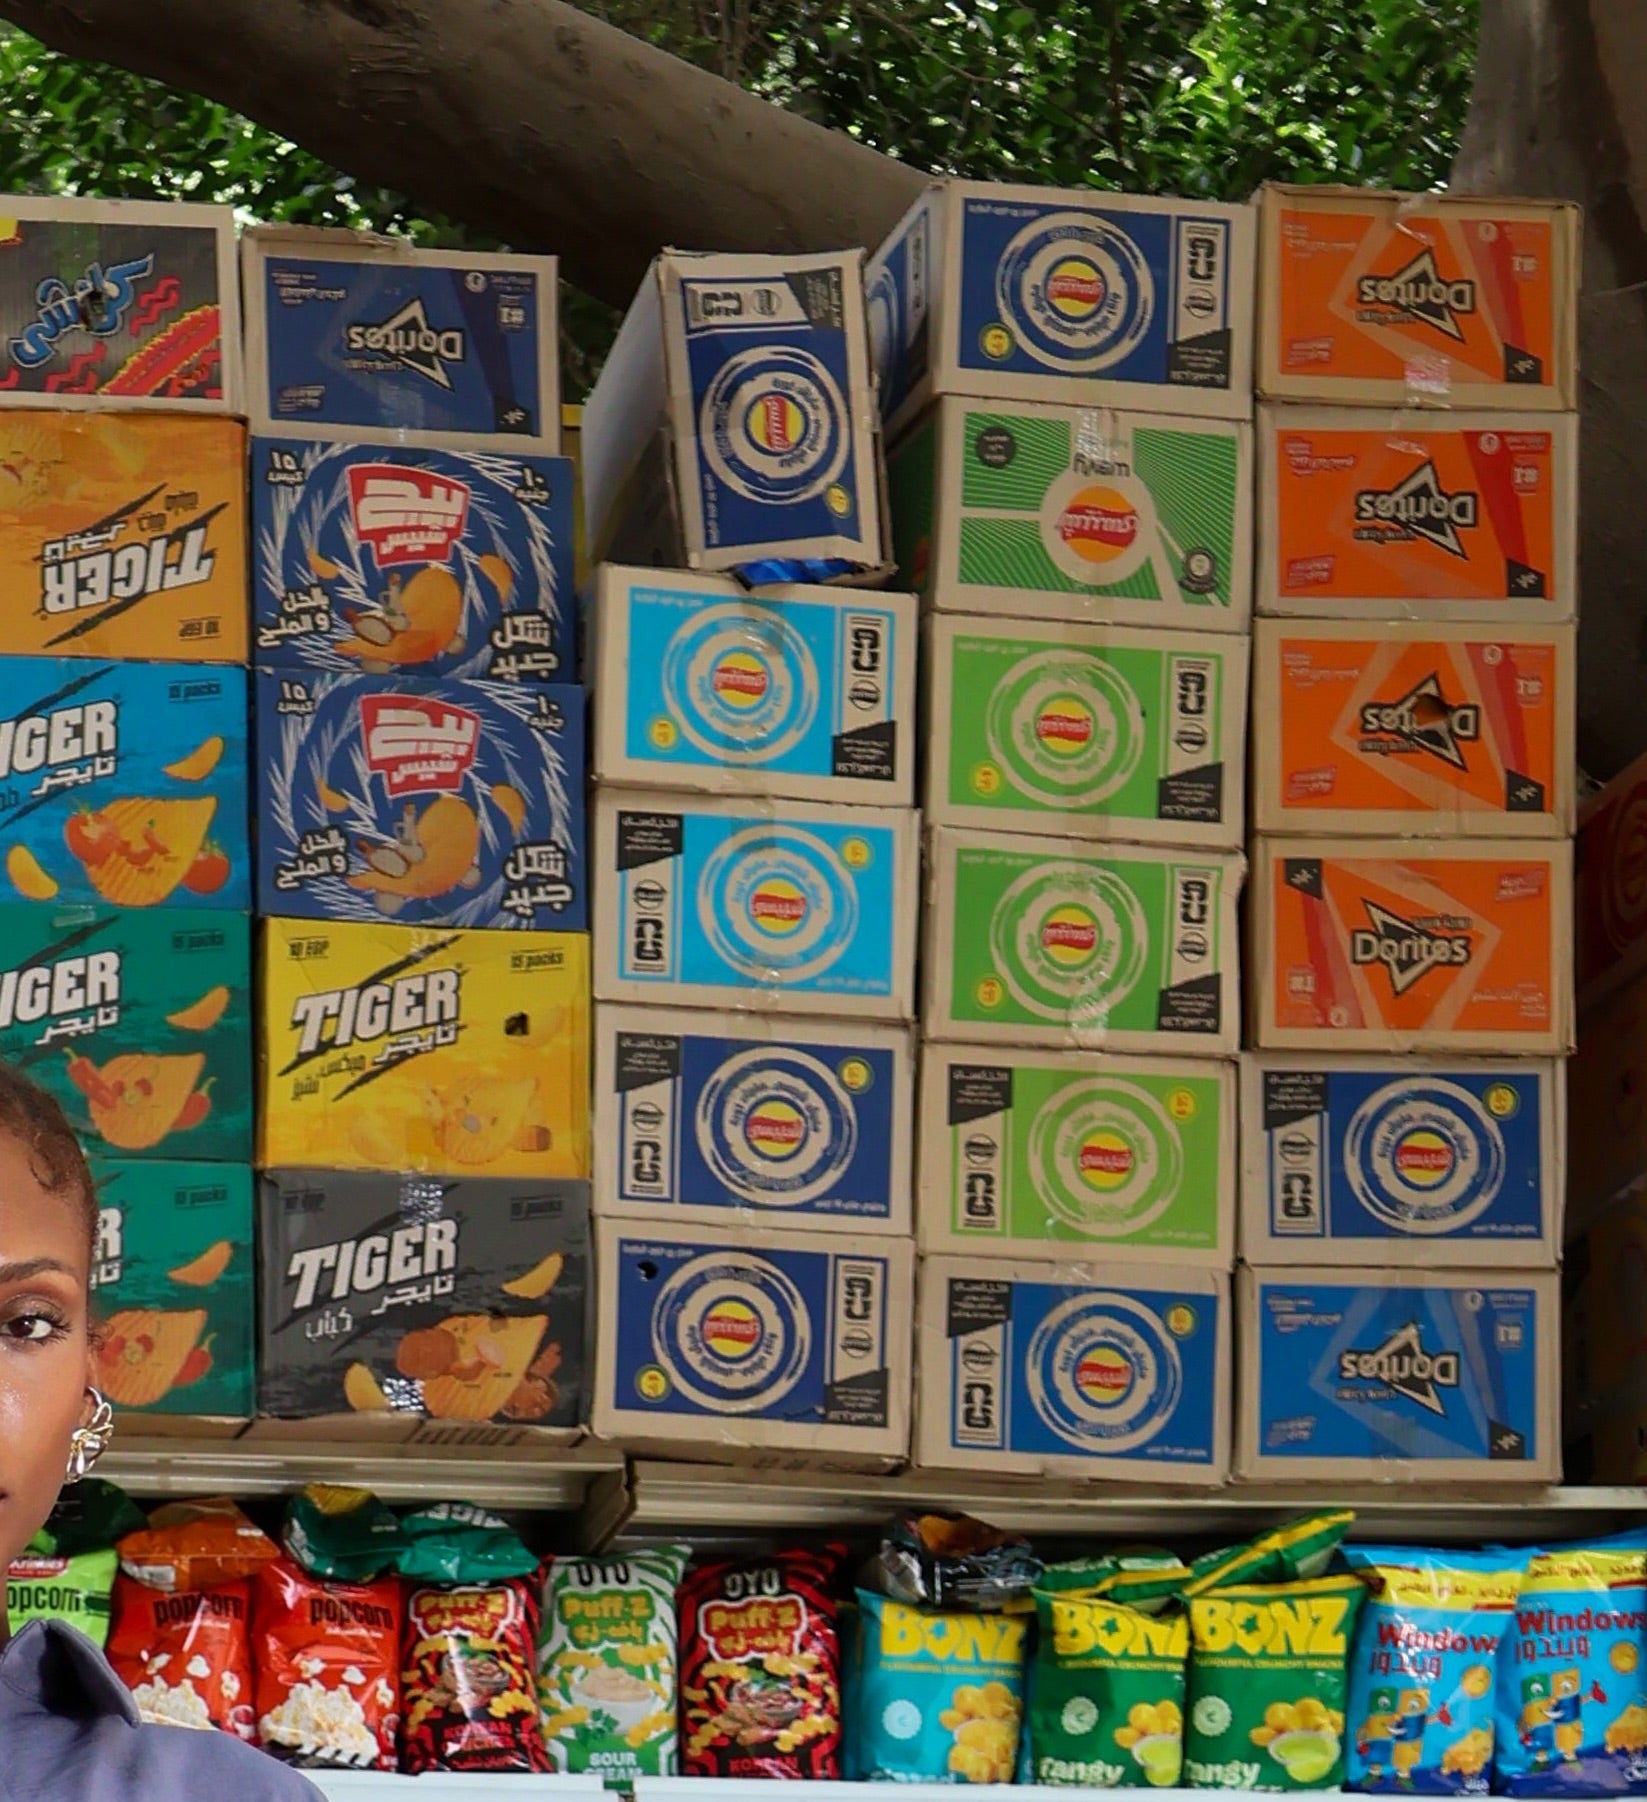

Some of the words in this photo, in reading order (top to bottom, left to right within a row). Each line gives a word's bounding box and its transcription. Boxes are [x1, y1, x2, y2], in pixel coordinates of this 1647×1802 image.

[1358, 276, 1475, 313] Doritos
[346, 323, 465, 364] Doritos
[1356, 489, 1475, 528] Doritos
[44, 527, 214, 614] TIGER
[1353, 932, 1469, 966] Doritos
[290, 968, 461, 1055] TIGER
[287, 1219, 459, 1309] TIGER
[1339, 1352, 1458, 1387] Doritos
[153, 1594, 243, 1629] popcorn
[310, 1596, 394, 1630] popcorn
[1192, 1597, 1349, 1655] BONZ
[880, 1601, 1027, 1664] BONZ
[589, 1752, 637, 1767] SOUR
